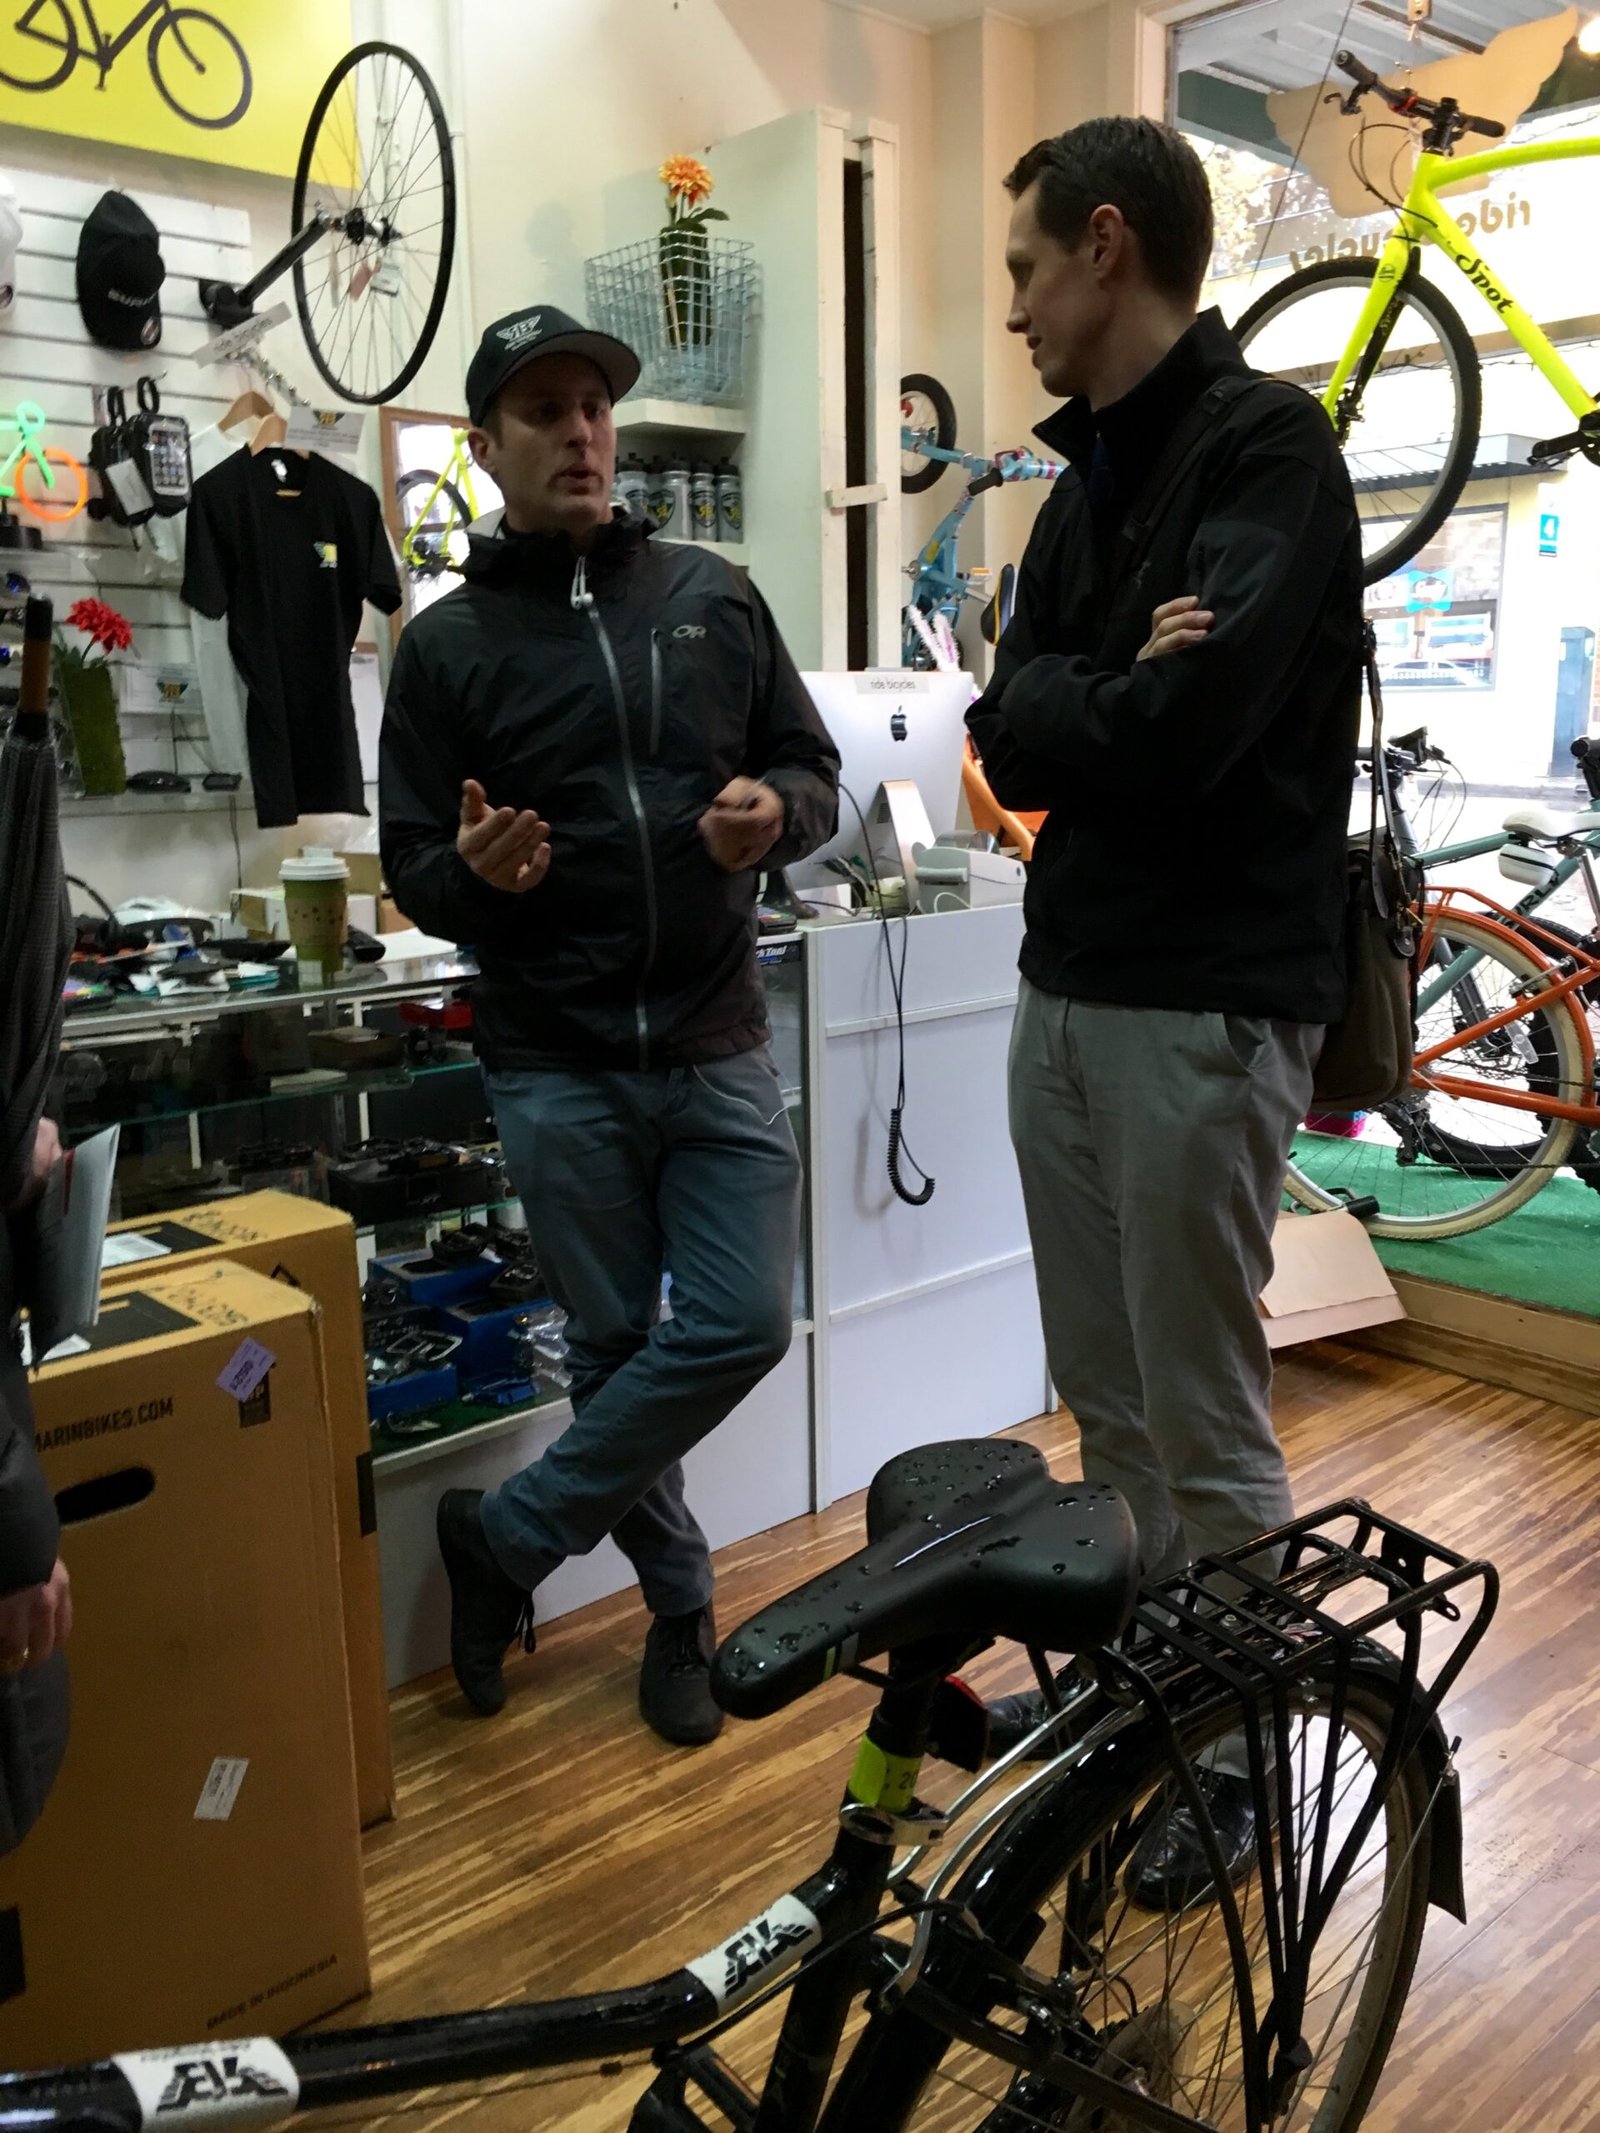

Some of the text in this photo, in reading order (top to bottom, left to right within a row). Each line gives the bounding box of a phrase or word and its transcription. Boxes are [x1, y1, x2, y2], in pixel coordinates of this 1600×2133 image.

[1455, 254, 1516, 314] Spot
[671, 624, 707, 639] OR
[207, 2002, 247, 2030] MADE
[265, 1954, 338, 1999] INDONESIA
